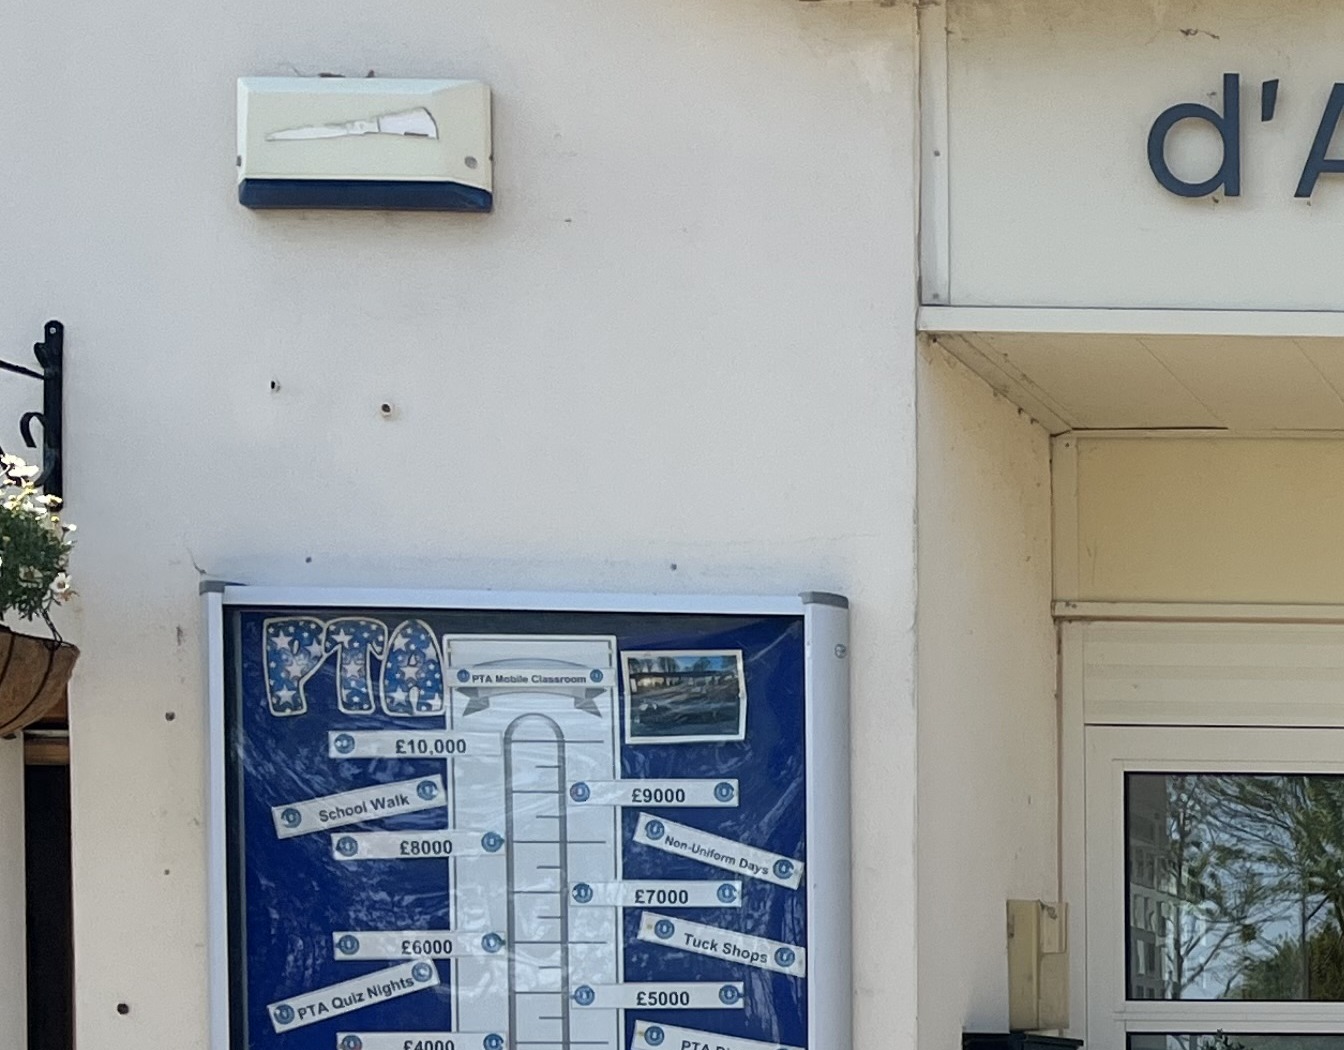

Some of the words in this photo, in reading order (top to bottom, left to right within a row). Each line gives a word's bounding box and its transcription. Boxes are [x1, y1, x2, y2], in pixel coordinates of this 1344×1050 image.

[263, 616, 445, 717] PTA
[472, 674, 493, 684] PTA
[495, 674, 529, 684] Mobile
[531, 674, 587, 684] Classroom
[395, 738, 468, 758] £10,000
[631, 787, 687, 805] £9000
[318, 800, 369, 825] School
[369, 793, 410, 812] Walk
[399, 839, 454, 857] £8000
[664, 835, 736, 866] Non-Uniform
[738, 858, 770, 878] Days
[634, 888, 690, 906] £7000
[400, 939, 454, 957] £6000
[684, 932, 721, 955] Tuck
[723, 940, 769, 967] Shops
[297, 1002, 329, 1021] PTA
[331, 987, 364, 1010] Quiz
[366, 977, 415, 998] Nights
[636, 990, 691, 1008] £5000
